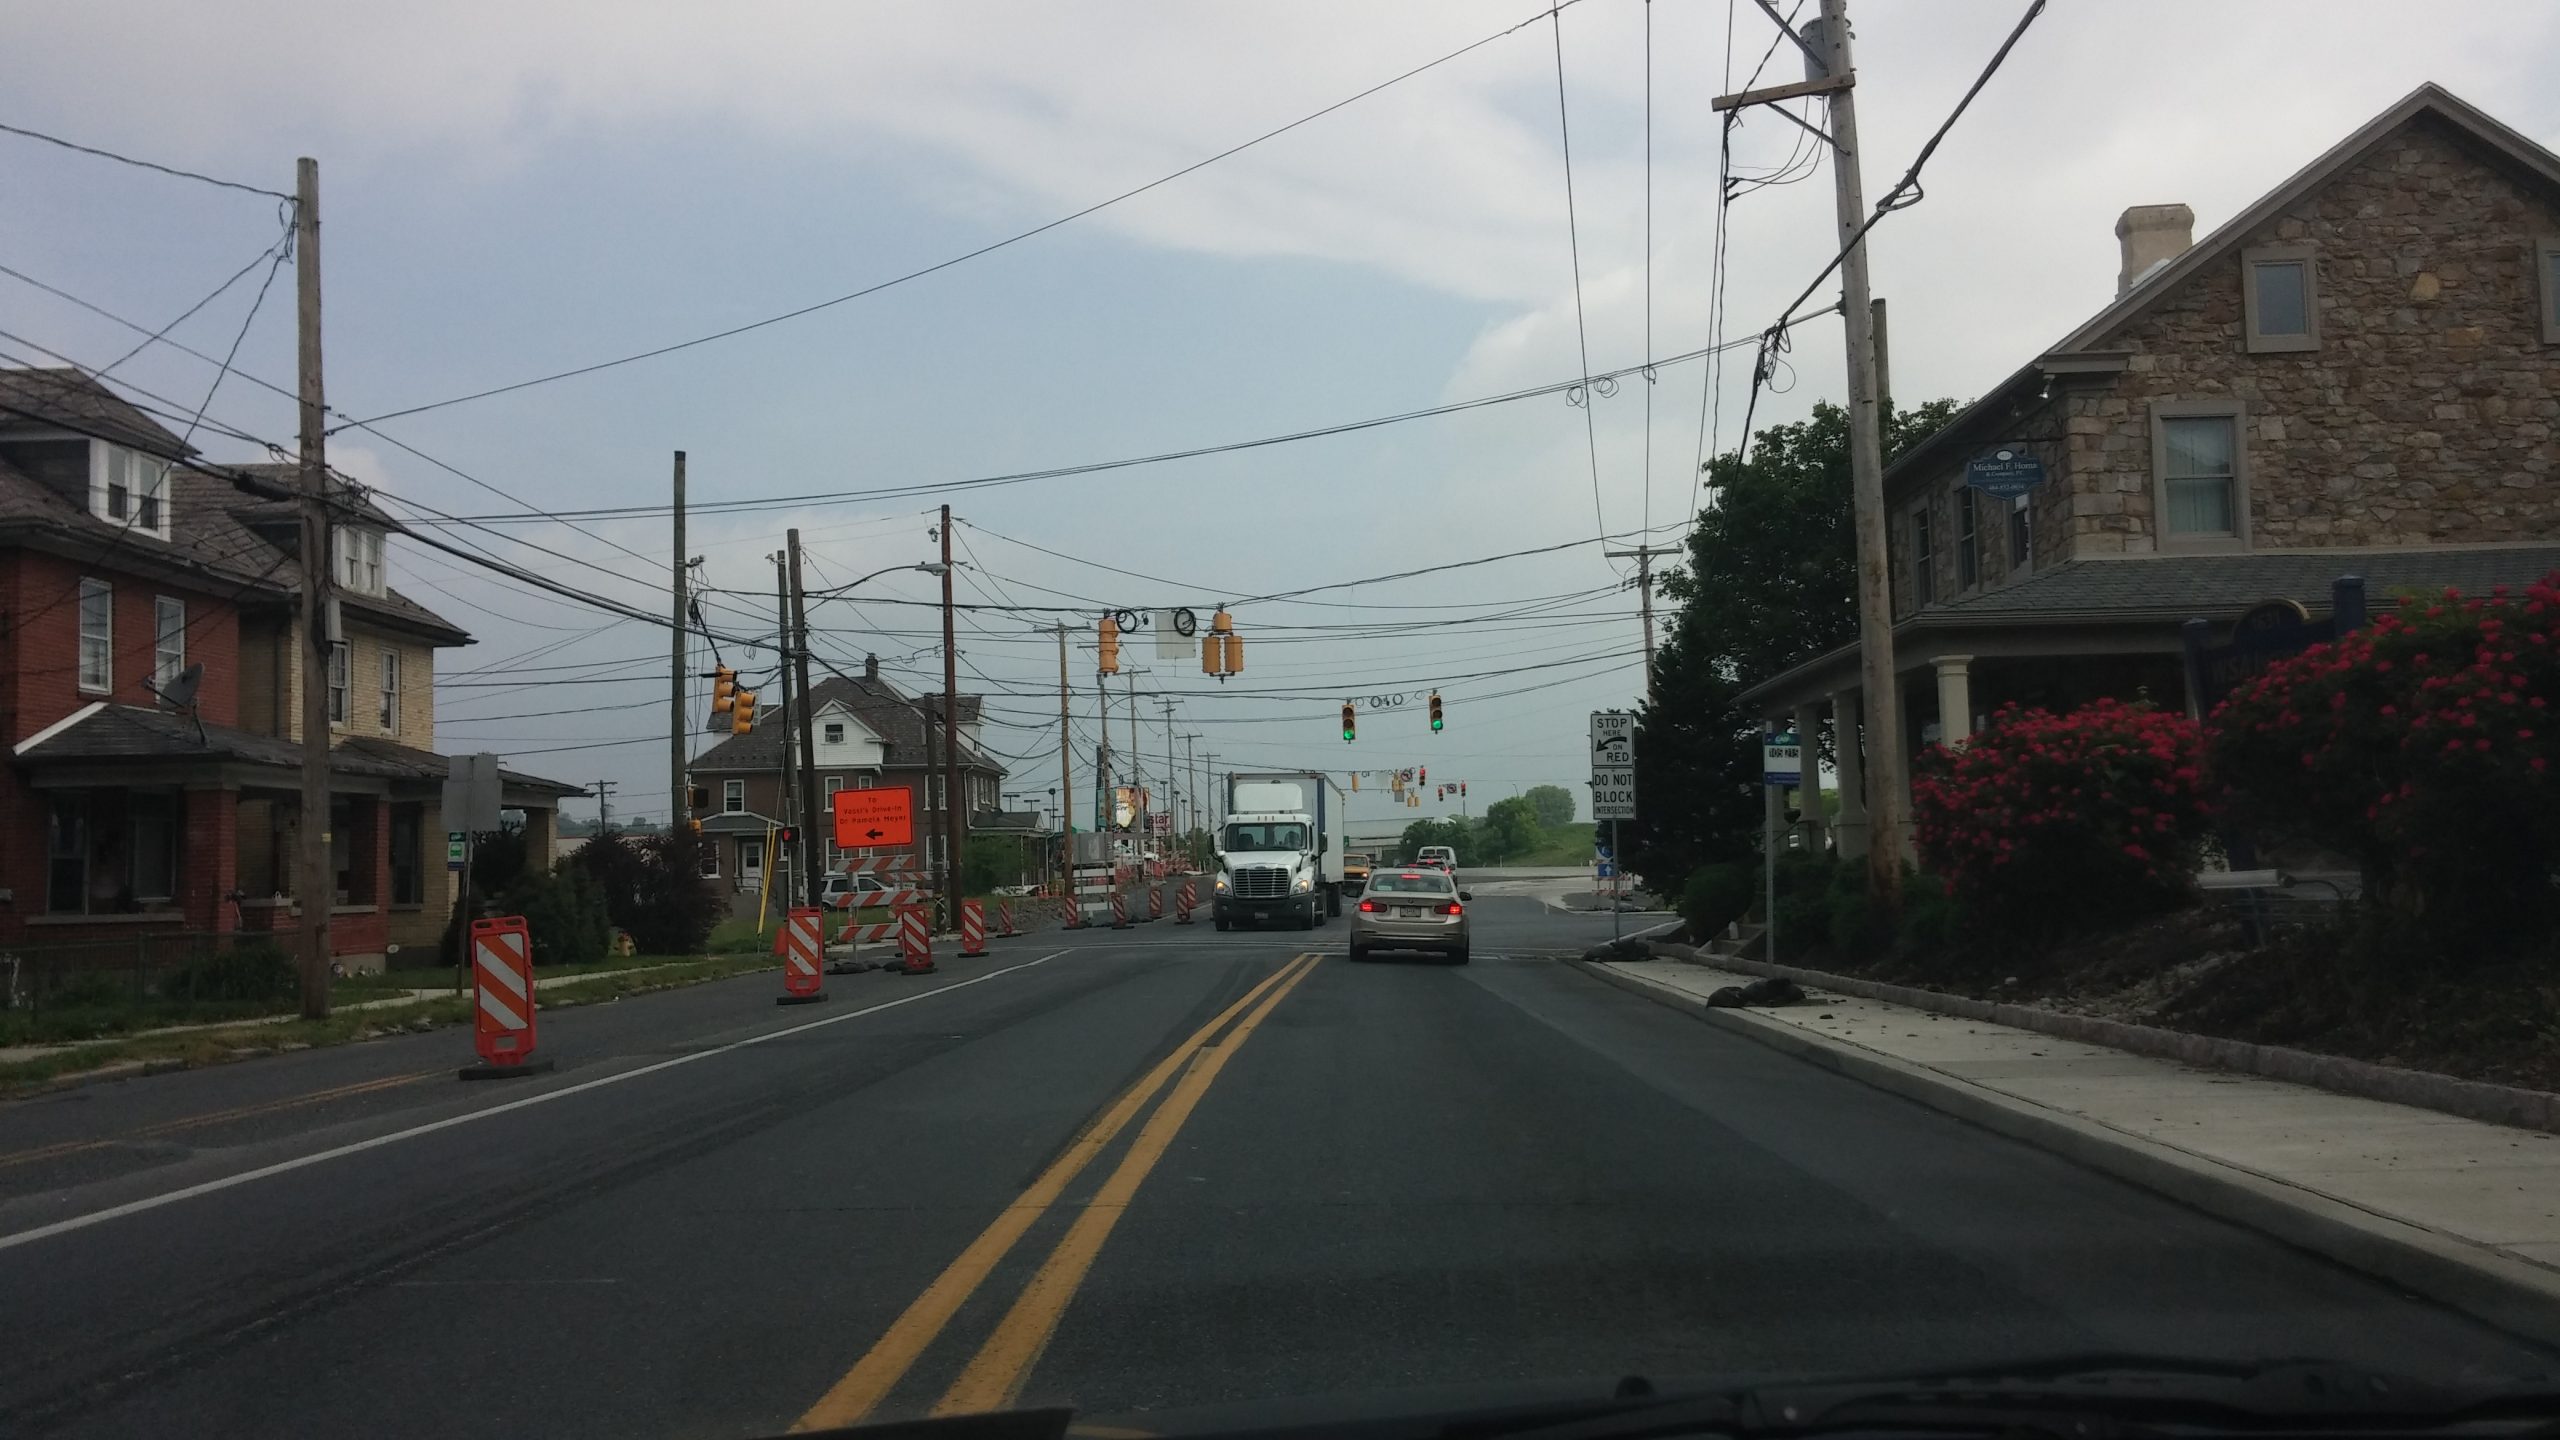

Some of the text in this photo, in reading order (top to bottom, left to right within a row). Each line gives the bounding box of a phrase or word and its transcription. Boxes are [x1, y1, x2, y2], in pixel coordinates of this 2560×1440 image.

[1973, 463, 2004, 472] Michael
[1597, 718, 1627, 729] STOP
[1612, 743, 1623, 751] ON
[1606, 752, 1629, 762] RED
[1594, 773, 1633, 786] DO NOT
[1595, 790, 1633, 803] BLOCK
[1595, 805, 1634, 815] INTERSECTION
